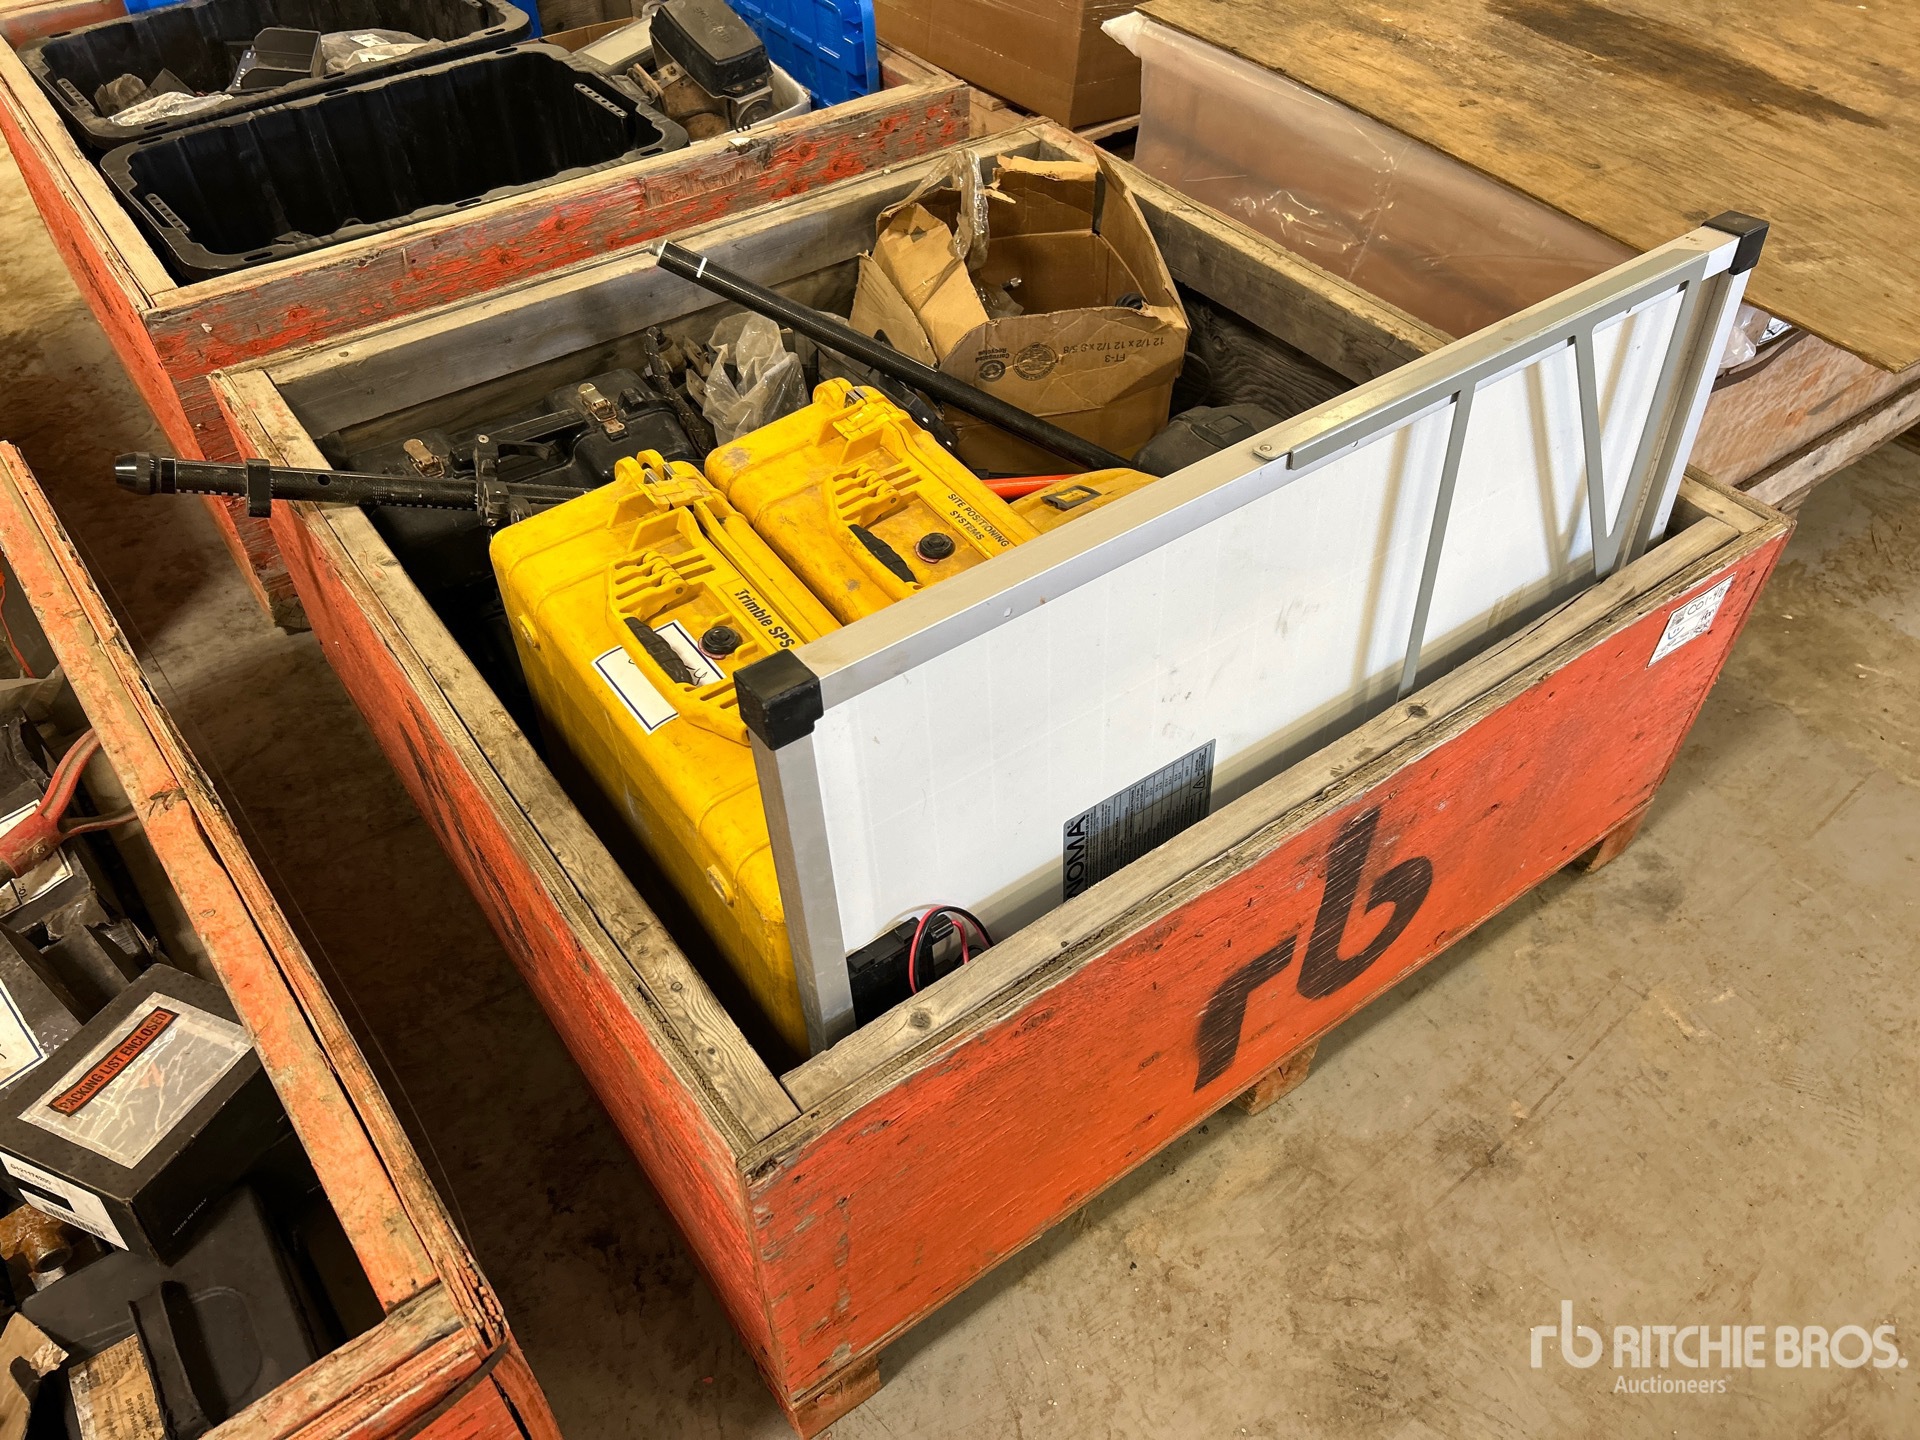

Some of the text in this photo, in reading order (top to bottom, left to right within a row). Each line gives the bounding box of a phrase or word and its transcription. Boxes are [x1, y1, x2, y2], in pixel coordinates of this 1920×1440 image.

[1096, 342, 1111, 351] 1/2
[1114, 340, 1125, 350] 12
[1136, 339, 1151, 348] 1/2
[1153, 337, 1165, 346] 12
[1104, 353, 1126, 363] FT-3
[948, 493, 1010, 547] SITE POSITIONING
[950, 510, 985, 540] SYSTEMS
[734, 588, 796, 648] Trimble SPS
[1066, 814, 1086, 899] NOMA
[60, 1013, 168, 1110] PACKING LIST ENCLOSED
